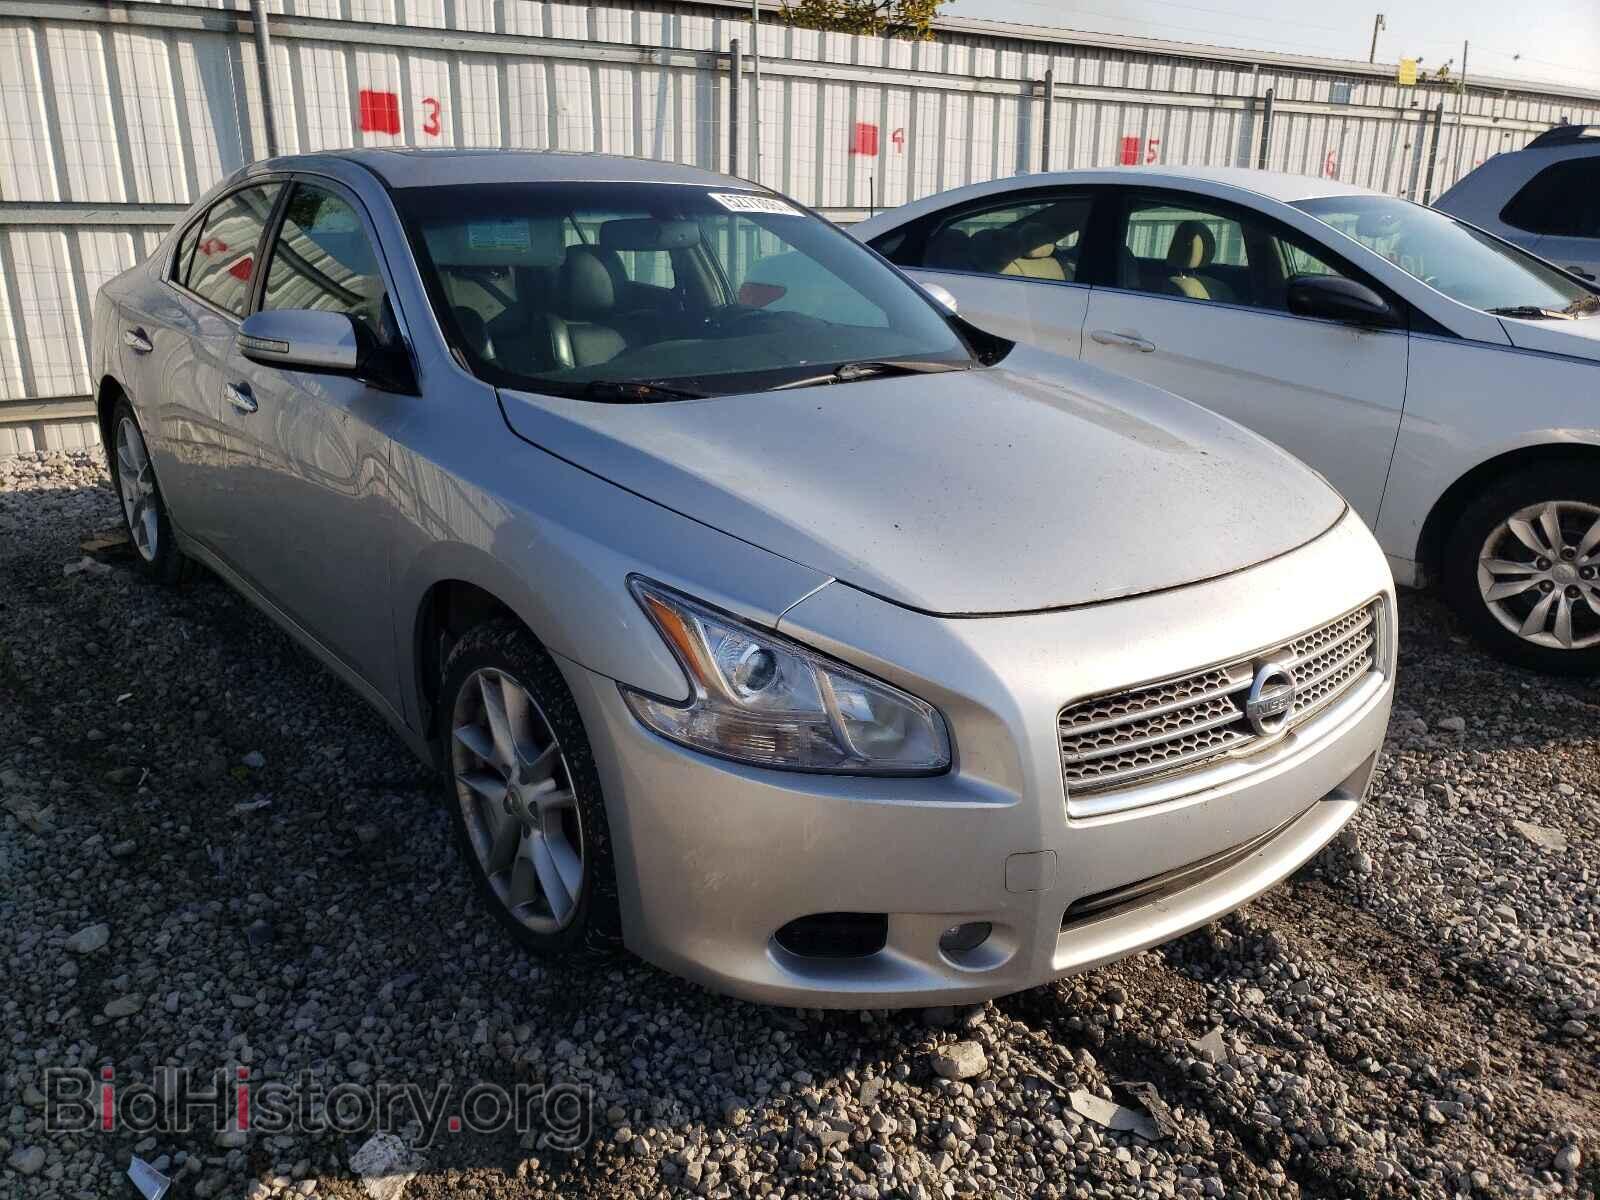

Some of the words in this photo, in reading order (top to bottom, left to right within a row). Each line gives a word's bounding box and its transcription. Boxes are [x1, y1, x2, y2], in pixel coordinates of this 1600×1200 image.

[421, 97, 441, 136] 3
[1146, 139, 1160, 163] 5
[1325, 151, 1336, 177] 6
